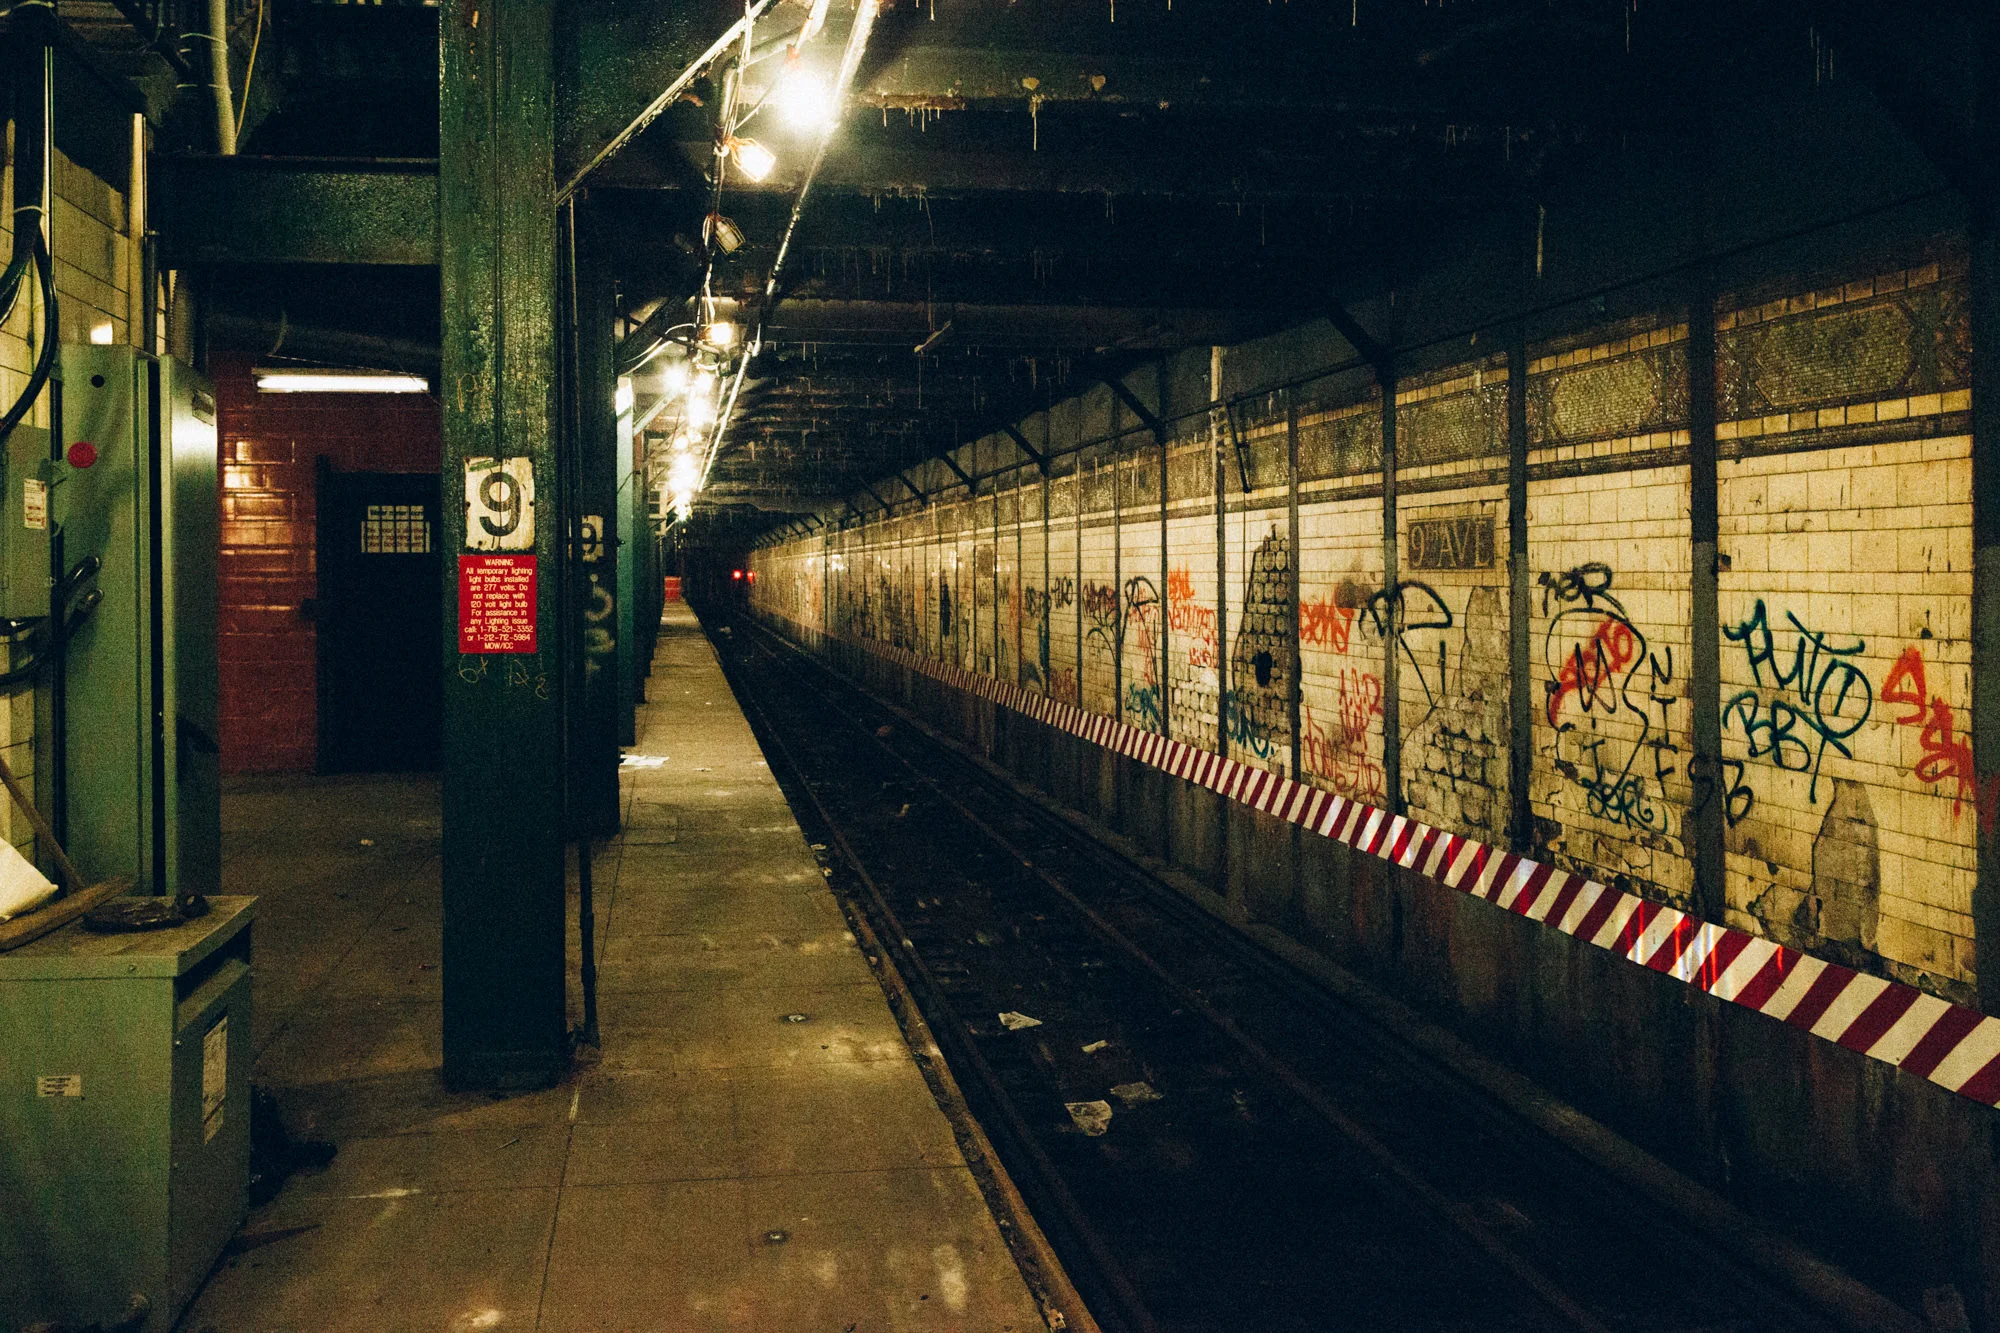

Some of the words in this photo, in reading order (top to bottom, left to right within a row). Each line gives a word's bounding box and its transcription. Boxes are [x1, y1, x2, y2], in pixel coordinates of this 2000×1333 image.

[479, 471, 522, 537] 9
[484, 558, 514, 566] WARNING
[466, 567, 474, 575] All
[477, 568, 508, 576] temporary
[511, 567, 533, 576] lighting
[469, 576, 482, 584] light
[473, 592, 483, 600] not
[486, 592, 509, 600] replace
[499, 601, 512, 609] light
[484, 617, 509, 626] Lighting
